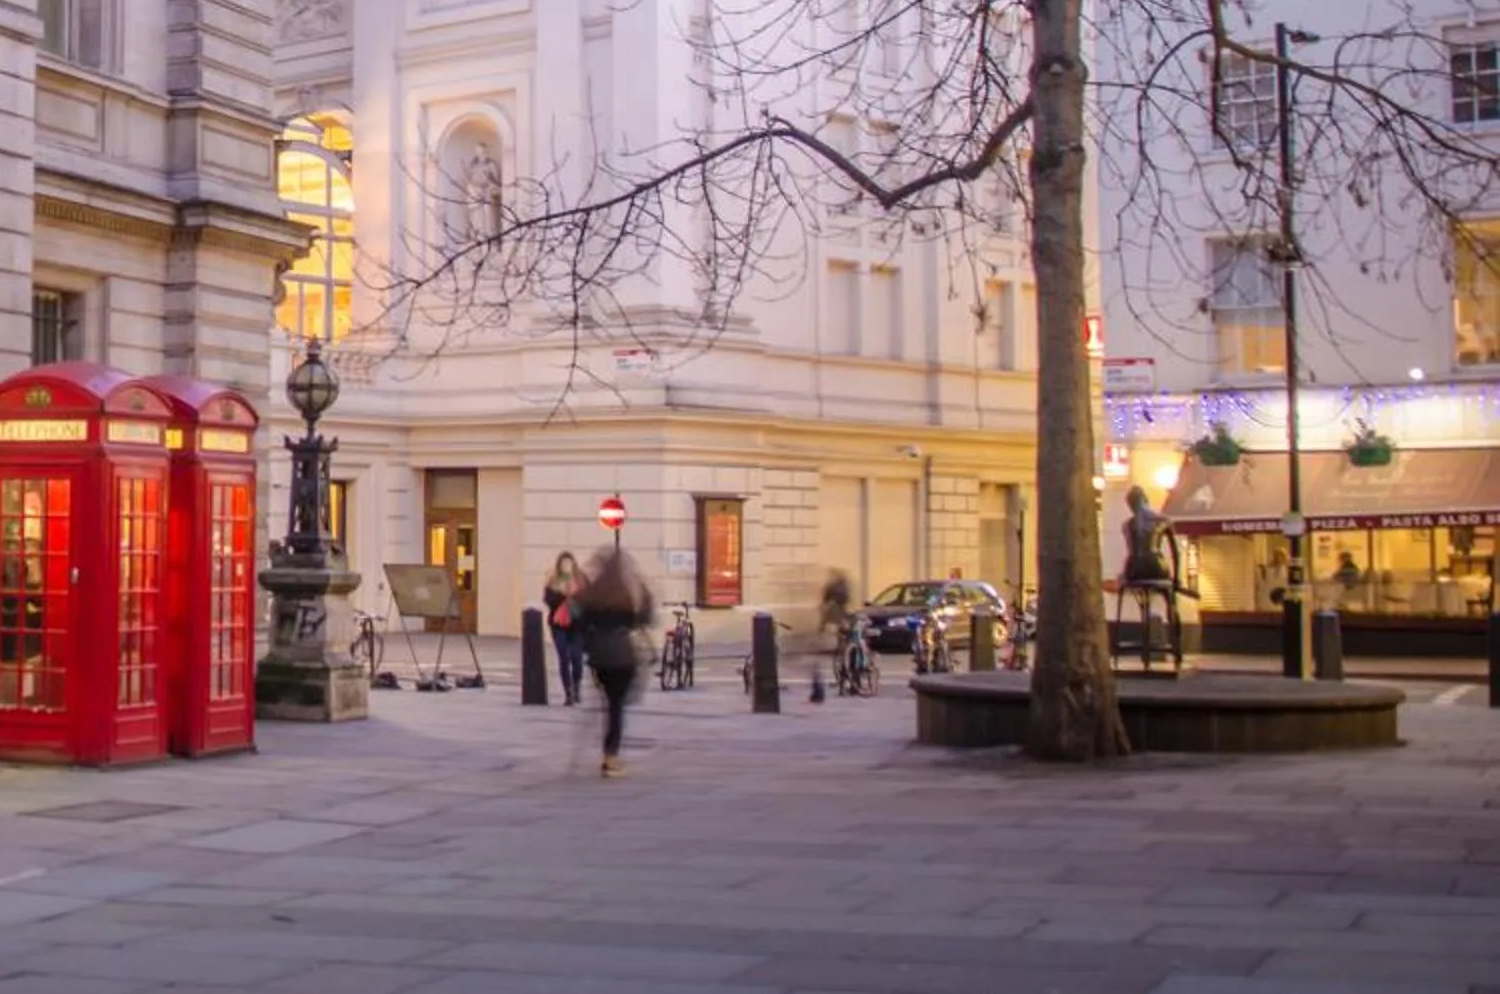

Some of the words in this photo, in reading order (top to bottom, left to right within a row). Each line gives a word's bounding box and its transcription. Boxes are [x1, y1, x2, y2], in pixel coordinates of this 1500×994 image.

[1311, 517, 1357, 529] PIZZA
[1380, 515, 1434, 527] PASTA
[1437, 513, 1481, 525] ALSO
